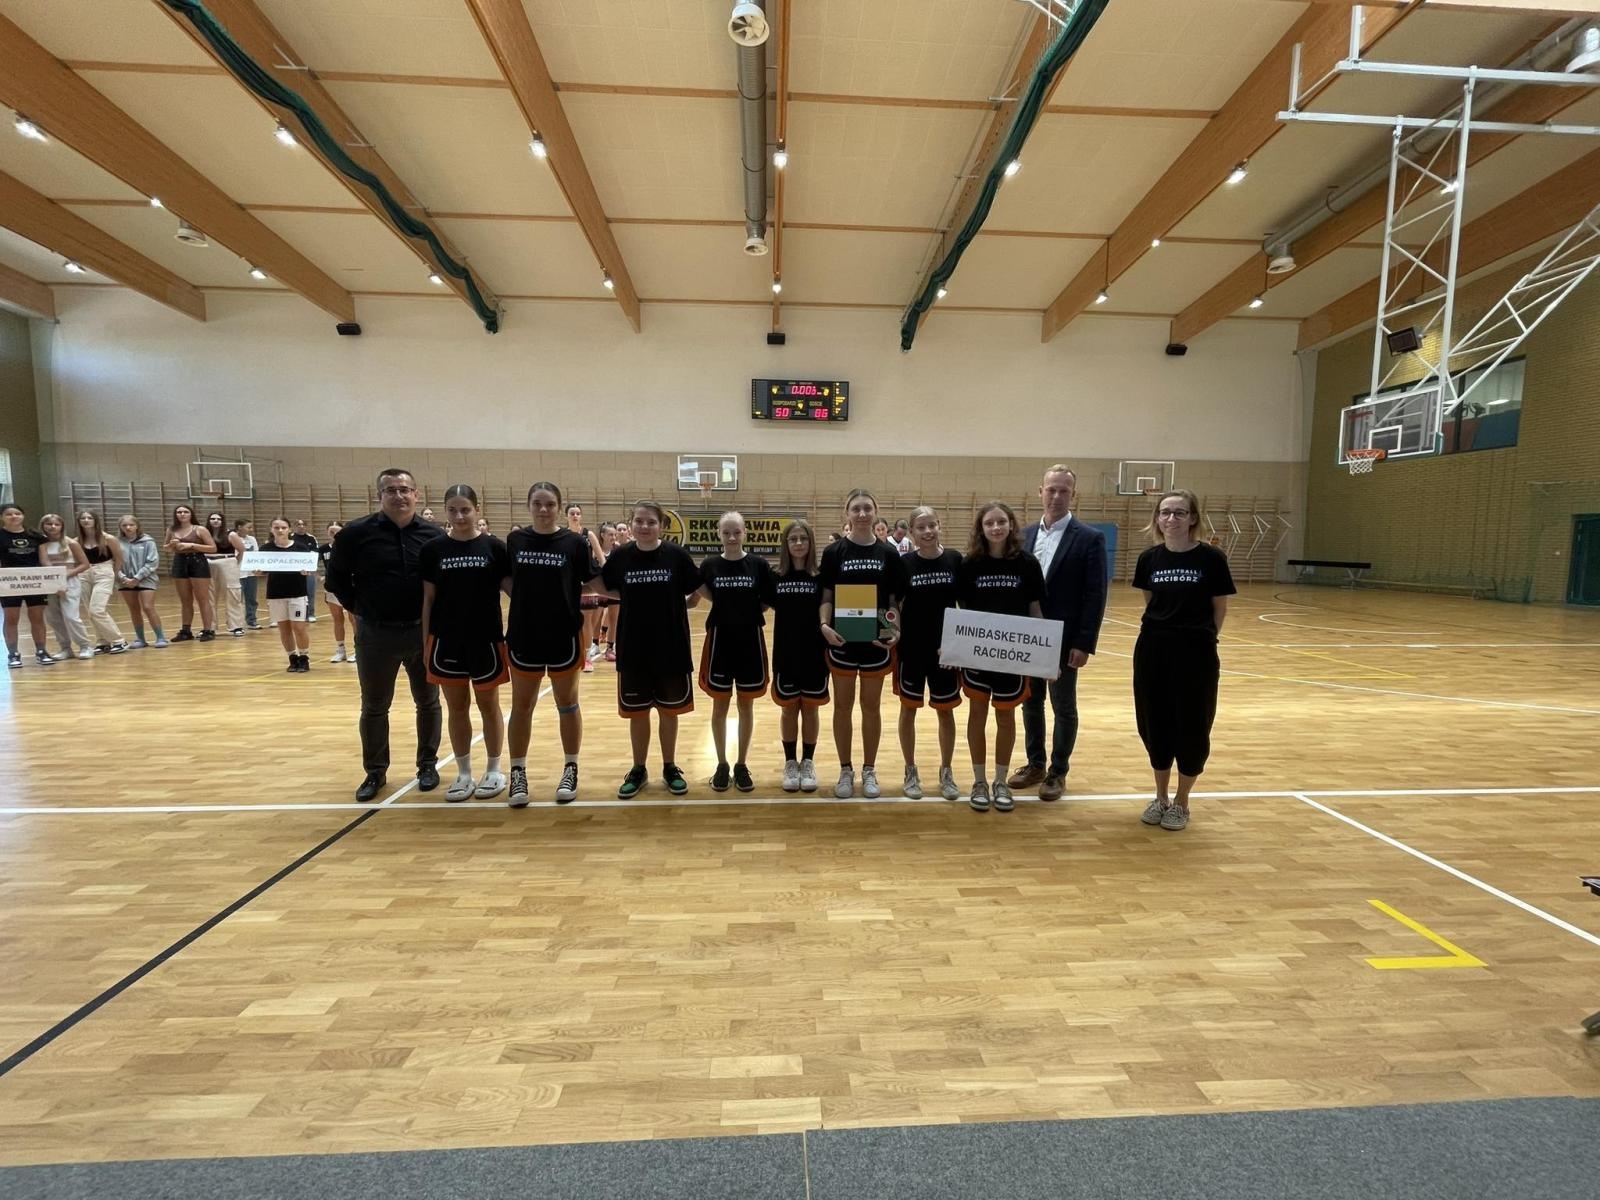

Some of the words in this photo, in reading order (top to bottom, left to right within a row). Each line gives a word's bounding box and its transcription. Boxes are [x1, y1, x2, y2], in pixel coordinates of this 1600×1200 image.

[775, 407, 789, 417] 50
[745, 520, 781, 531] AWIA
[747, 532, 782, 543] RAW
[441, 560, 486, 570] RACIBÓRZ
[517, 557, 562, 567] RACIBÓRZ
[843, 563, 881, 572] RACIBÓRZ
[626, 575, 669, 584] RACIBÓRZ
[912, 577, 951, 587] RACIBÓRZ
[977, 580, 1017, 588] RACIBÓRZ
[1153, 575, 1199, 583] RACIBÓRZ
[955, 624, 1052, 648] MINIBASKETBALL
[973, 645, 1031, 663] RACIBÓRZ
